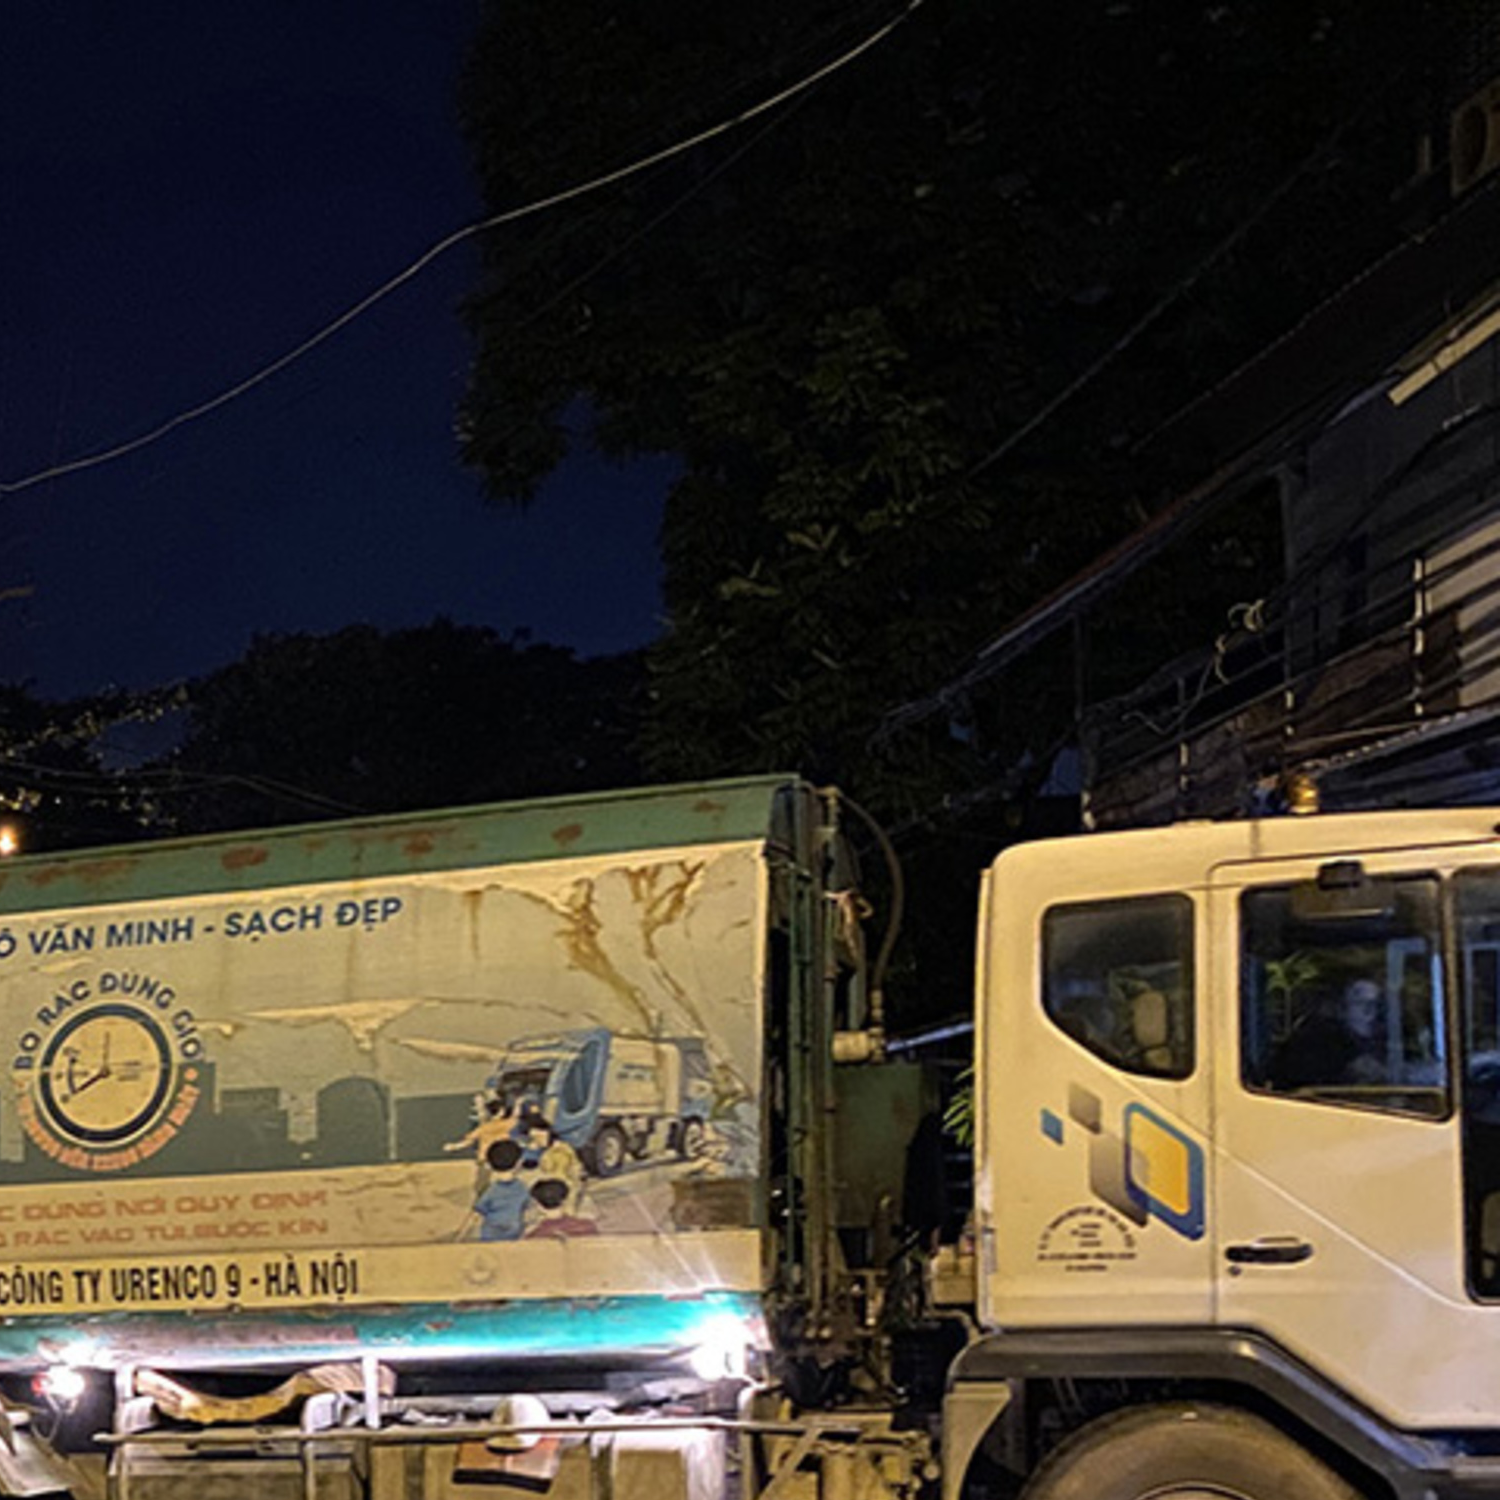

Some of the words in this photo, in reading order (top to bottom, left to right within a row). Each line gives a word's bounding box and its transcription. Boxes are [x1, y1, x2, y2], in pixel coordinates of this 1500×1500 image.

[28, 924, 95, 953] VĂN
[105, 917, 194, 948] MINH
[224, 905, 323, 942] SẠCH
[335, 897, 402, 932] ĐẸP
[72, 1268, 102, 1303] TY
[110, 1264, 217, 1301] URENCO
[224, 1263, 241, 1297] 9
[264, 1252, 303, 1296] HÀ
[309, 1251, 359, 1301] NỘI
